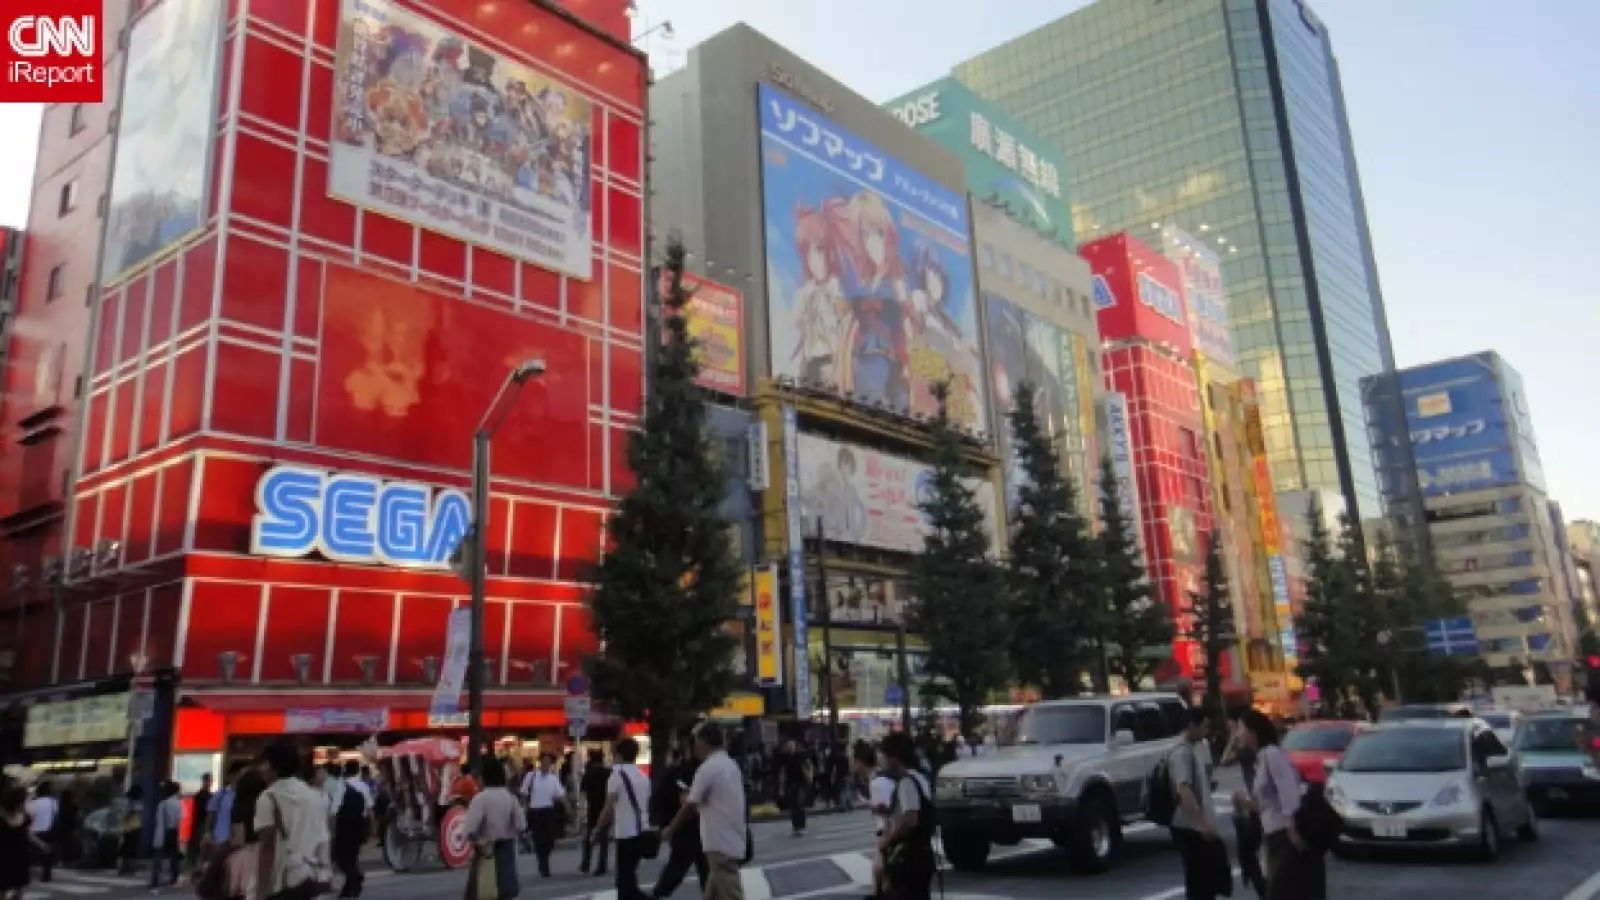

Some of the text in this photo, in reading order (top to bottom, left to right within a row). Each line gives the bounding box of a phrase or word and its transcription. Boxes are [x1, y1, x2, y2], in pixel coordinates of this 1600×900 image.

[770, 99, 885, 182] ソフマップ
[252, 466, 474, 568] SEGA
